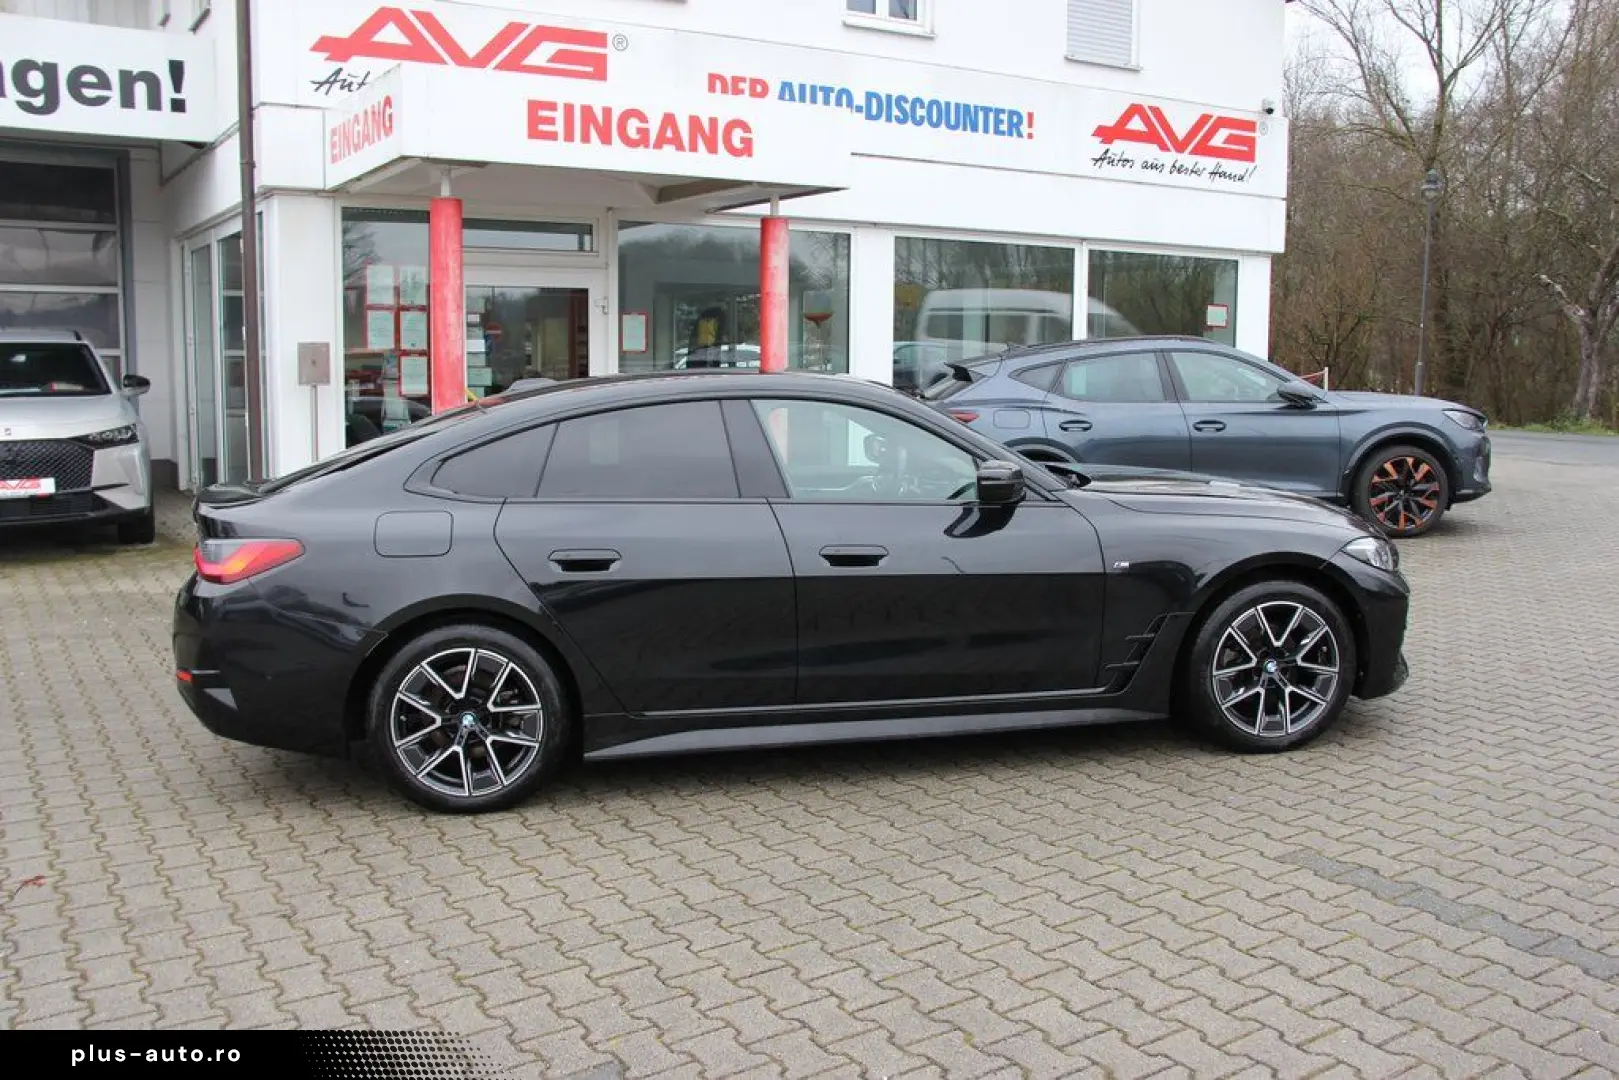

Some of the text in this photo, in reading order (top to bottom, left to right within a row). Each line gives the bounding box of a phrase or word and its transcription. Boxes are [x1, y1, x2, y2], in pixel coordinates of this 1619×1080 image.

[310, 6, 608, 81] AVG
[0, 58, 188, 115] gen!
[310, 67, 370, 95] Aut
[778, 80, 1035, 139] AUTO-DISCOUNTER!
[330, 95, 393, 164] EINGANG
[527, 99, 754, 158] EINGANG
[1091, 103, 1258, 163] AVG
[1091, 148, 1259, 184] Autos aus bester Hand!
